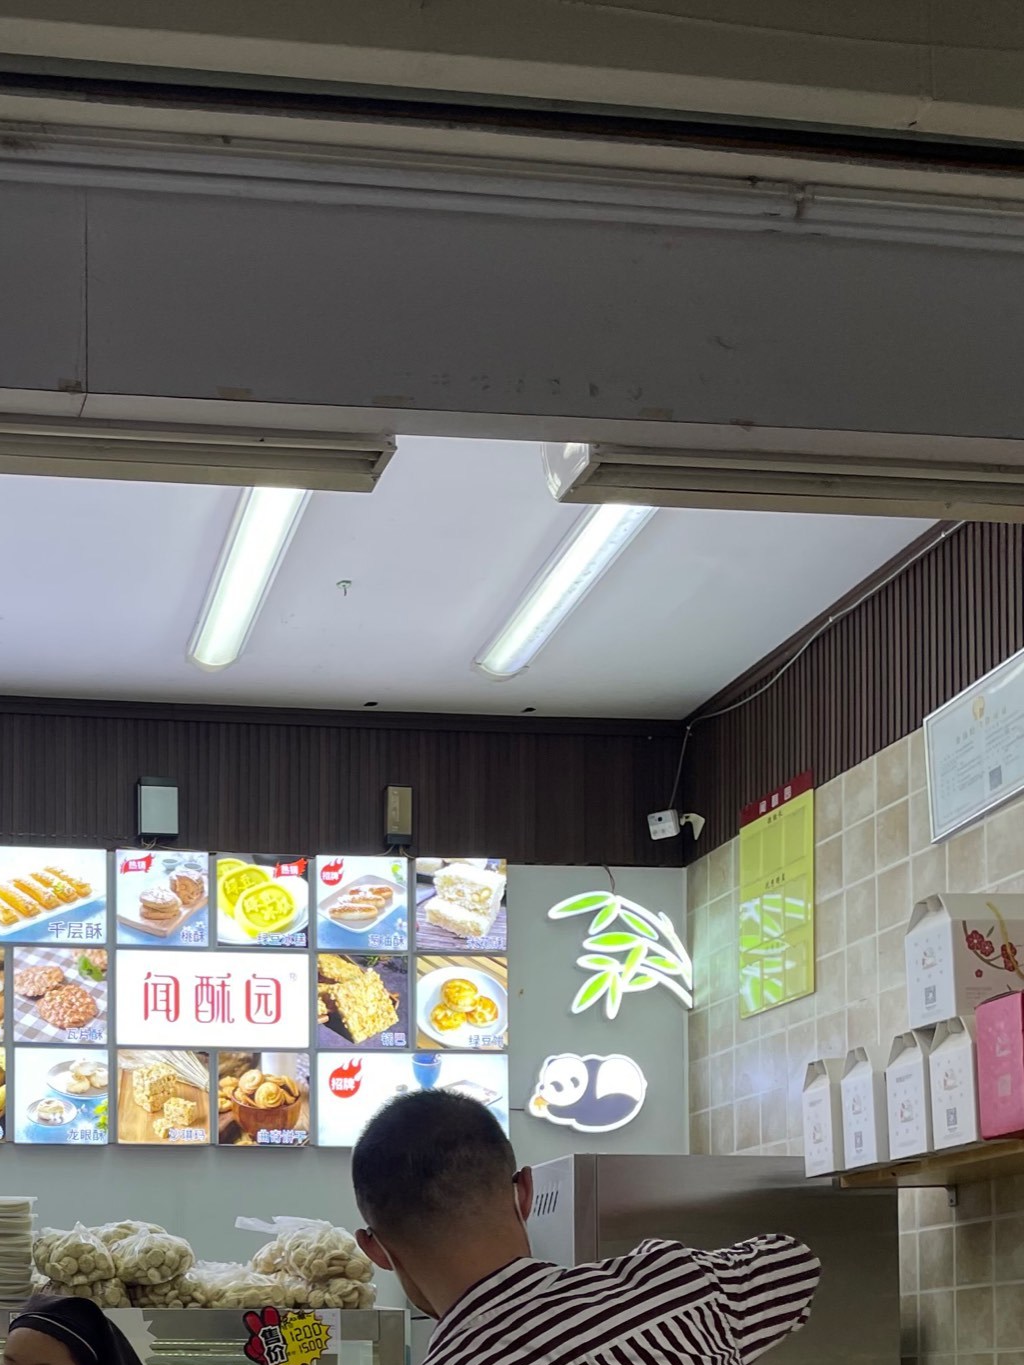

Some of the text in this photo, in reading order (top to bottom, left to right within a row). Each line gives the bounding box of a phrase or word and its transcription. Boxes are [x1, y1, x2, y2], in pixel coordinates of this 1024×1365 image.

[48, 921, 104, 939] 千层酥
[143, 971, 282, 1025] 闻酥园
[66, 1027, 103, 1041] 瓦片酥
[330, 1078, 356, 1092] 招牌
[66, 1128, 106, 1142] 龙眼酥
[260, 1326, 288, 1364] 售价
